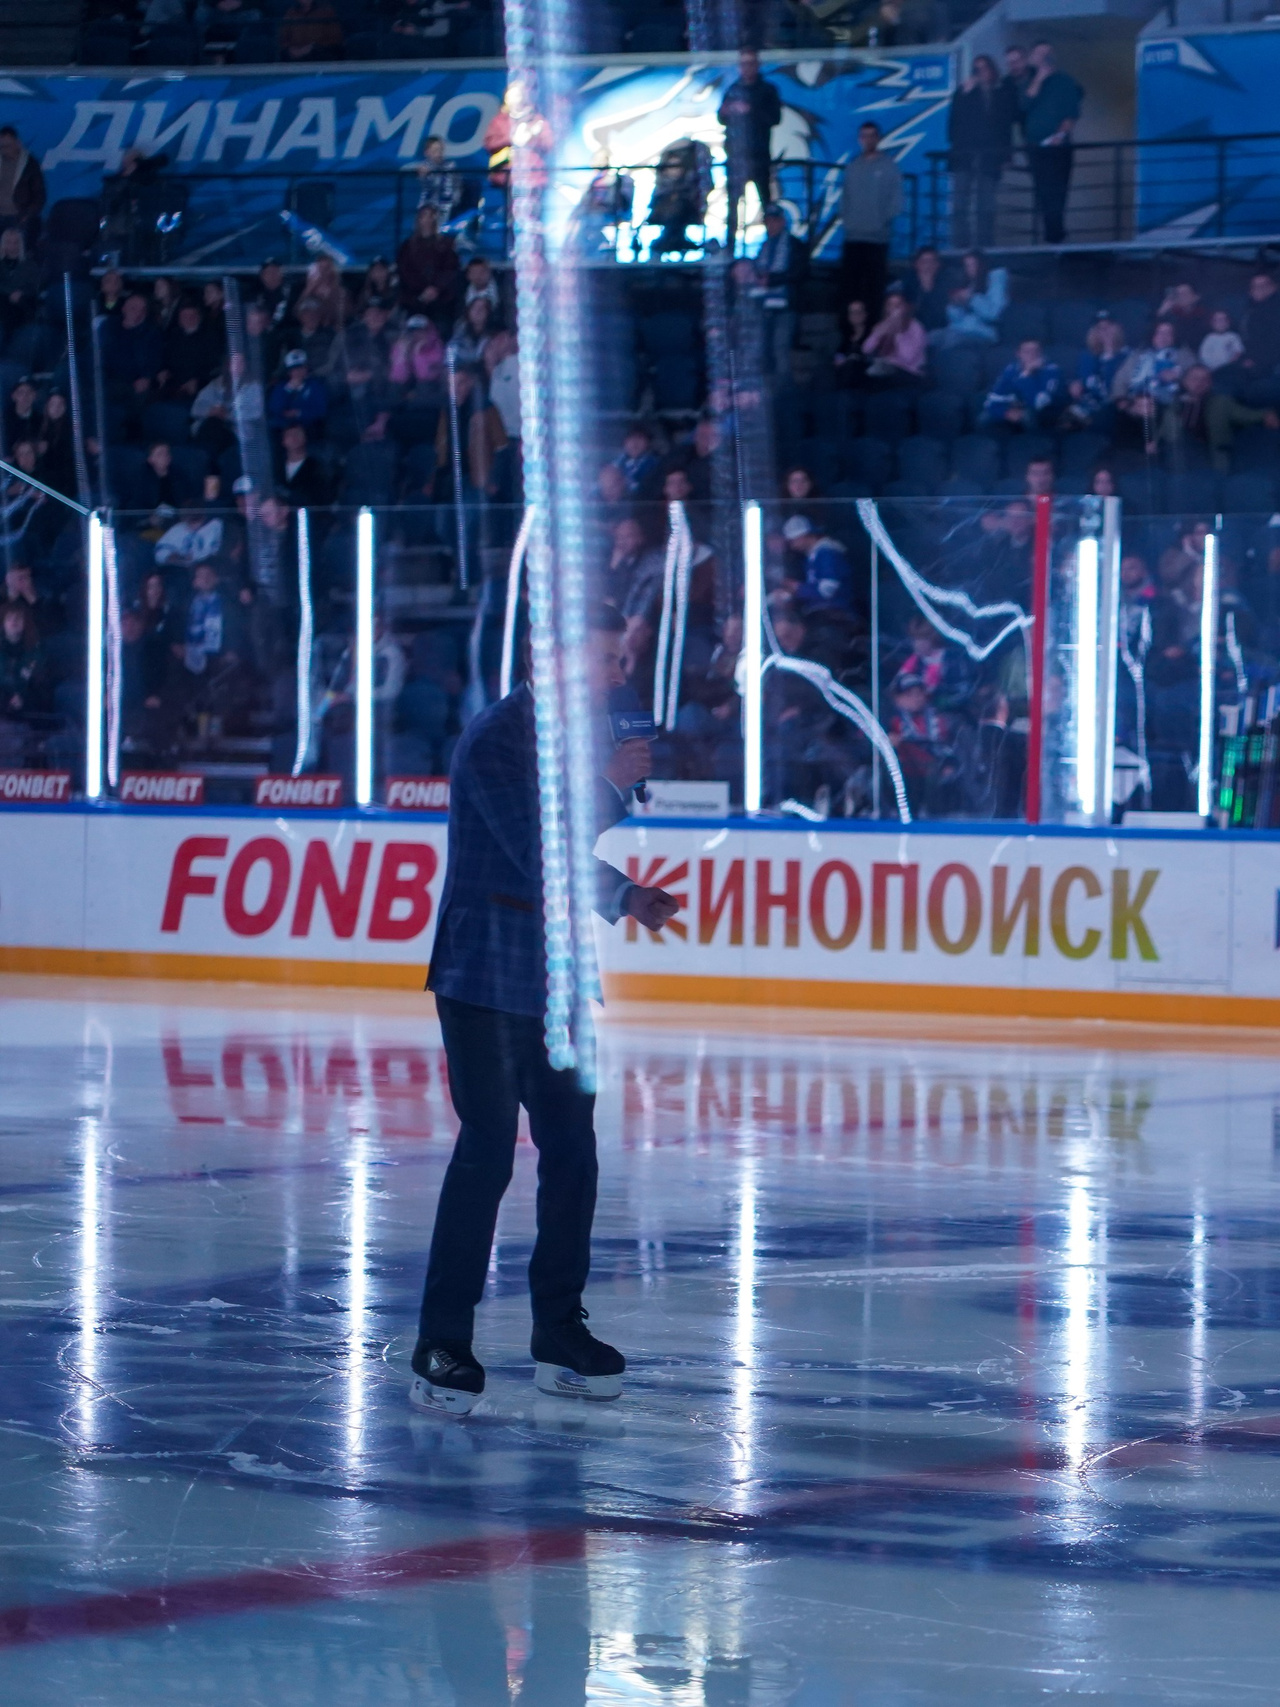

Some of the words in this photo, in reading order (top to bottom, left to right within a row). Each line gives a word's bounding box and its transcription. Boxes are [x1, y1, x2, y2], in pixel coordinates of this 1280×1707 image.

[42, 92, 502, 171] ДИНАМО
[121, 776, 200, 801] FONBET
[256, 779, 342, 806] FONBET
[387, 781, 450, 807] FONB
[160, 835, 438, 941] FONB
[625, 856, 1162, 962] КИНОПОИСК
